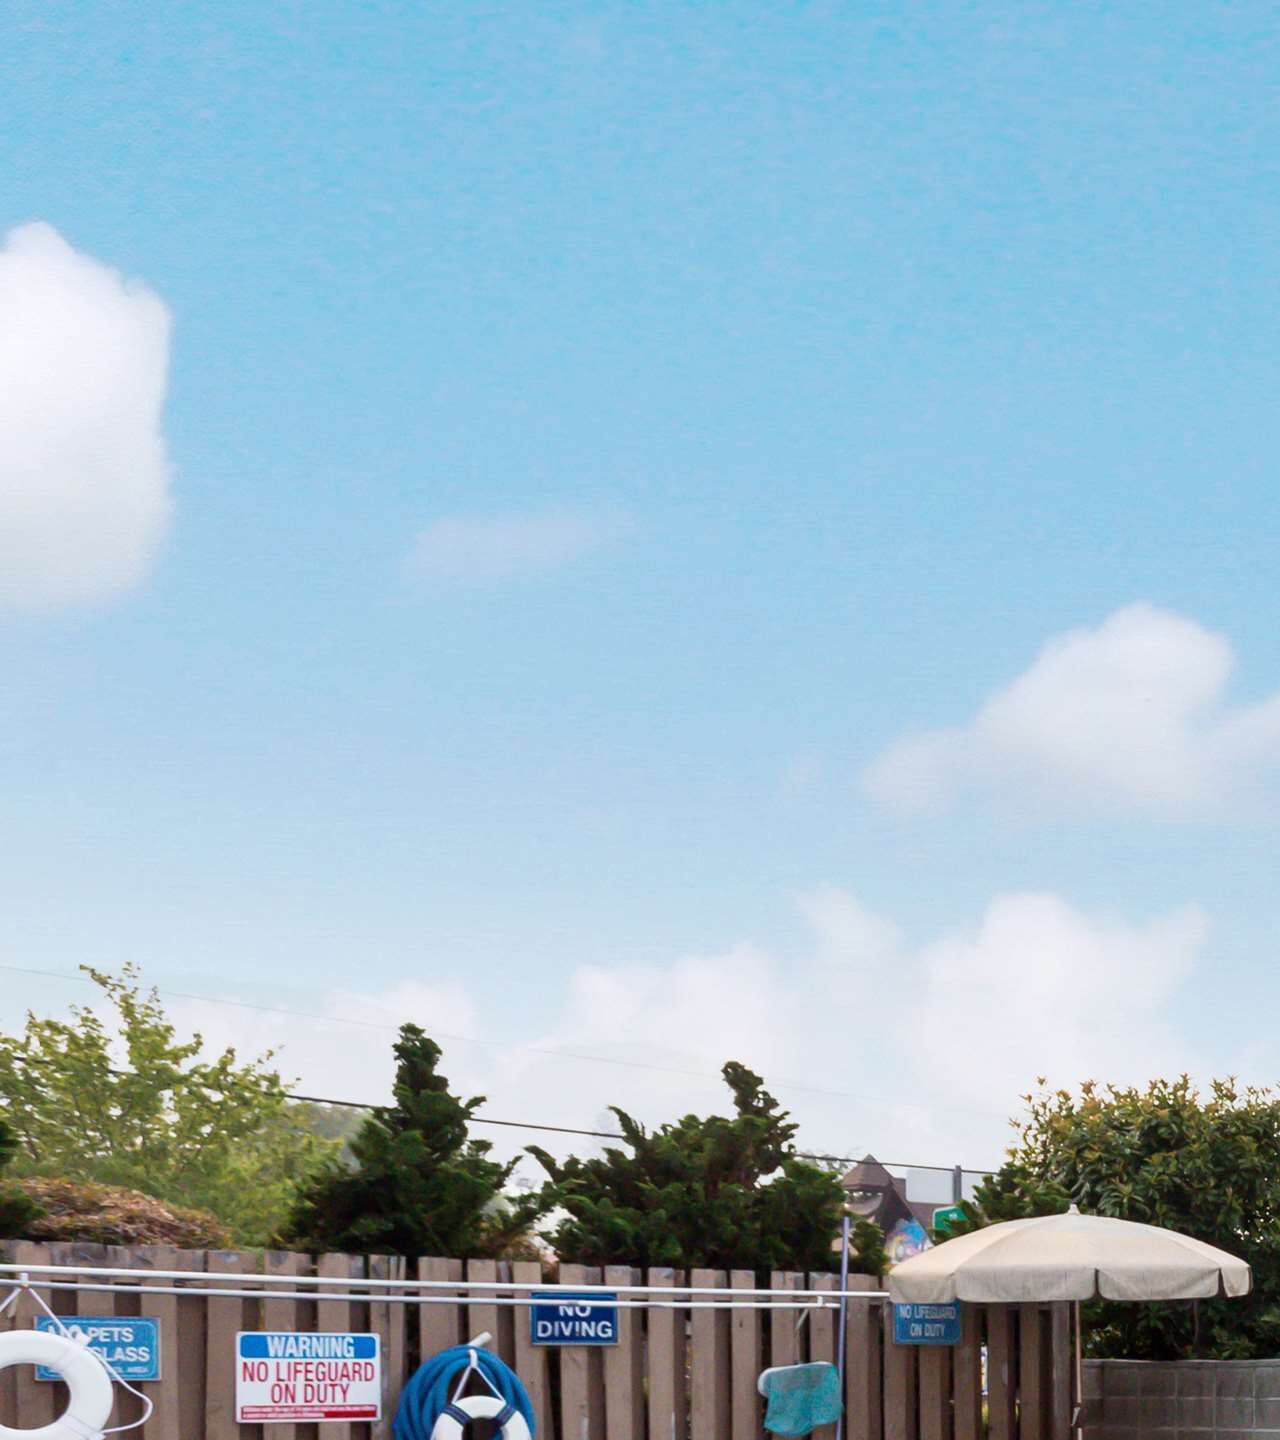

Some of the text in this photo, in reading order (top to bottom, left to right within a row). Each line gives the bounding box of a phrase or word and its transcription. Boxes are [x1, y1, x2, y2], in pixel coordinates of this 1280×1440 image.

[558, 1303, 592, 1318] NO
[899, 1304, 912, 1319] NO
[86, 1326, 135, 1343] PETS
[536, 1320, 613, 1338] DIVING
[911, 1323, 946, 1337] ON DUTY
[266, 1335, 355, 1358] WARNING
[241, 1361, 375, 1383] NO LIFEGUARD
[270, 1383, 351, 1404] ON DUTY
